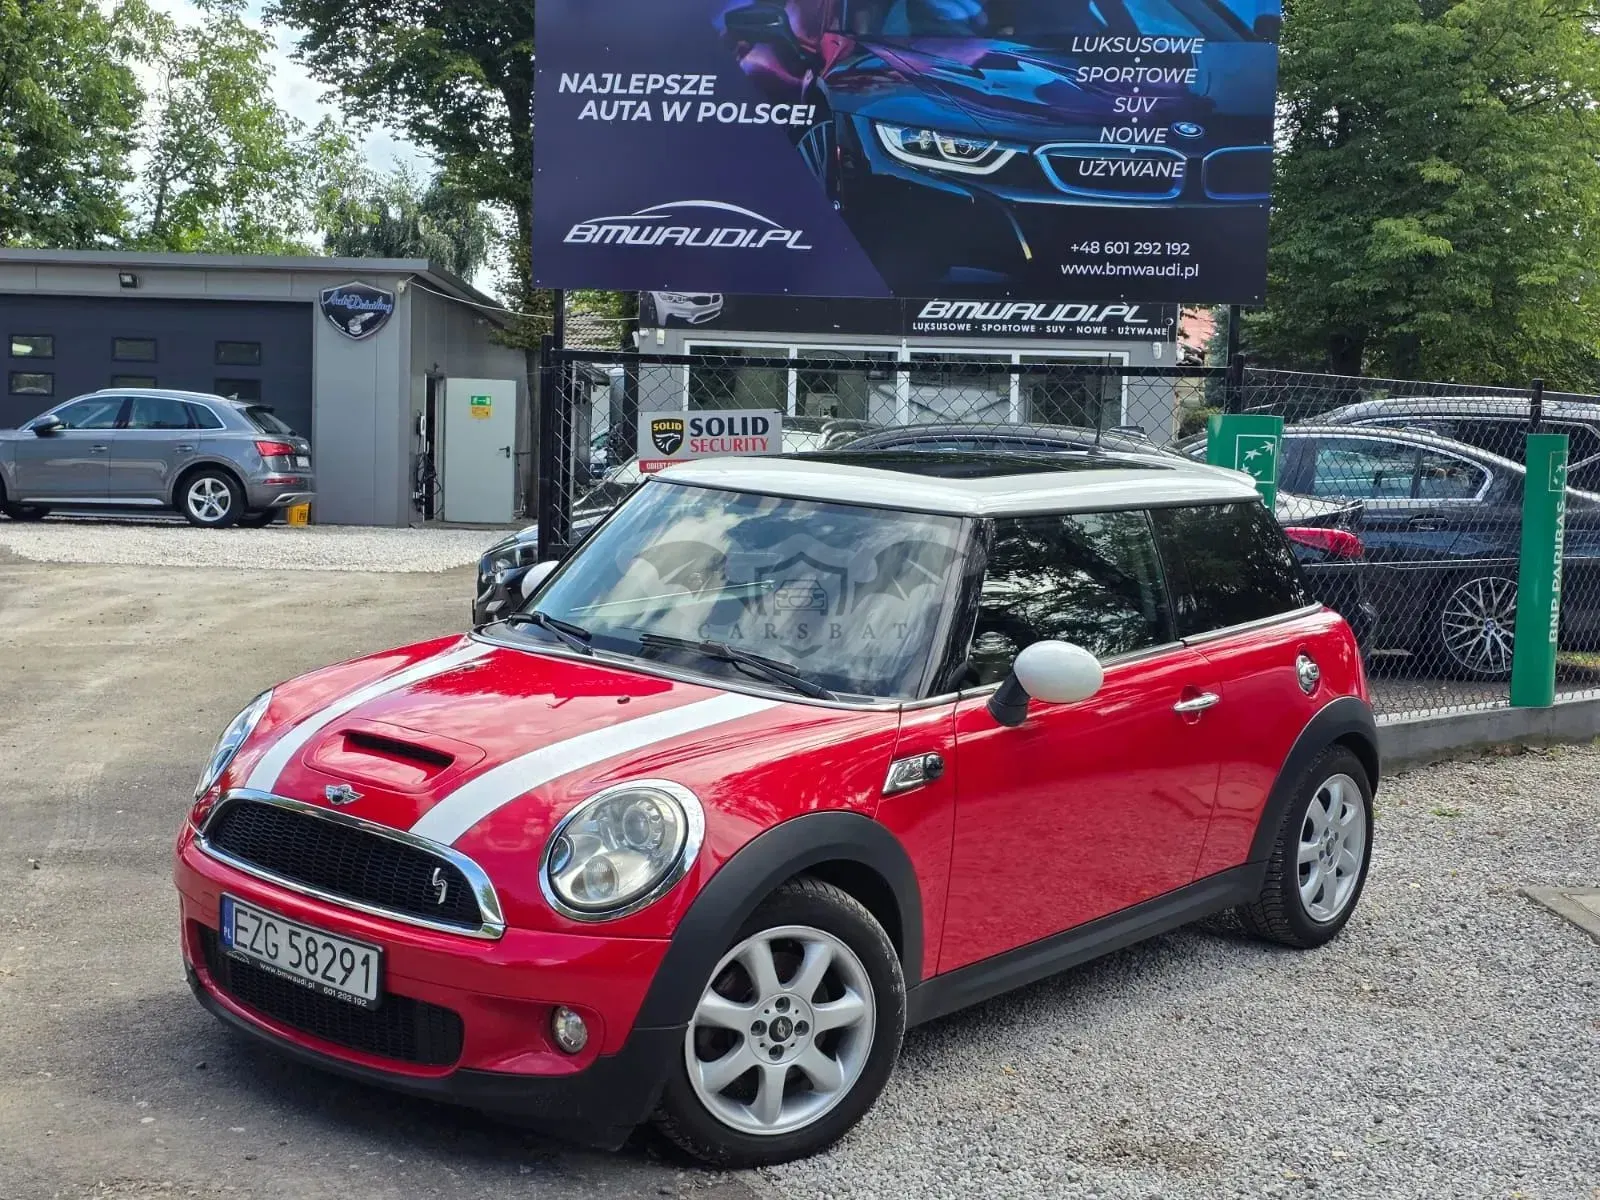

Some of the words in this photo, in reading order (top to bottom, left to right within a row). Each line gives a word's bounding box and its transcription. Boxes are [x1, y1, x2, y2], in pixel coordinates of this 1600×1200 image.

[1071, 36, 1205, 54] LUKSUSOWE
[558, 73, 717, 96] NAJLEPSZE
[1075, 66, 1199, 84] SPORTOWE
[578, 100, 652, 121] AUTA
[662, 101, 691, 122] W
[697, 102, 816, 125] POLSCE!
[1112, 97, 1157, 113] SUV
[1100, 127, 1169, 143] NOWE
[1079, 157, 1186, 178] UŻYWANE
[563, 224, 813, 250] BMWAUDI.PL
[1070, 241, 1100, 254] +48
[1104, 241, 1130, 255] 601
[1134, 242, 1162, 255] 292
[1165, 242, 1190, 256] 192
[1060, 262, 1199, 279] www.bmwaudi.pl
[918, 300, 1149, 323] BMWAUDI.PL
[912, 322, 971, 332] LUKSUSOWE
[981, 323, 1036, 333] SPORTOWE
[1046, 324, 1066, 334] SUV
[1076, 325, 1107, 335] NOWE
[1117, 325, 1168, 336] UŻYWANE
[653, 421, 682, 431] SOLID
[689, 416, 769, 437] SOLID
[690, 437, 769, 453] SECURITY
[1551, 501, 1565, 592] PARIBAS
[1549, 599, 1560, 642] BNP
[234, 908, 279, 960] EZG
[288, 929, 371, 994] 58291
[259, 961, 316, 989] www.bmwaudi.pl
[323, 986, 336, 998] 601
[337, 990, 352, 1002] 292
[353, 996, 368, 1007] 192
